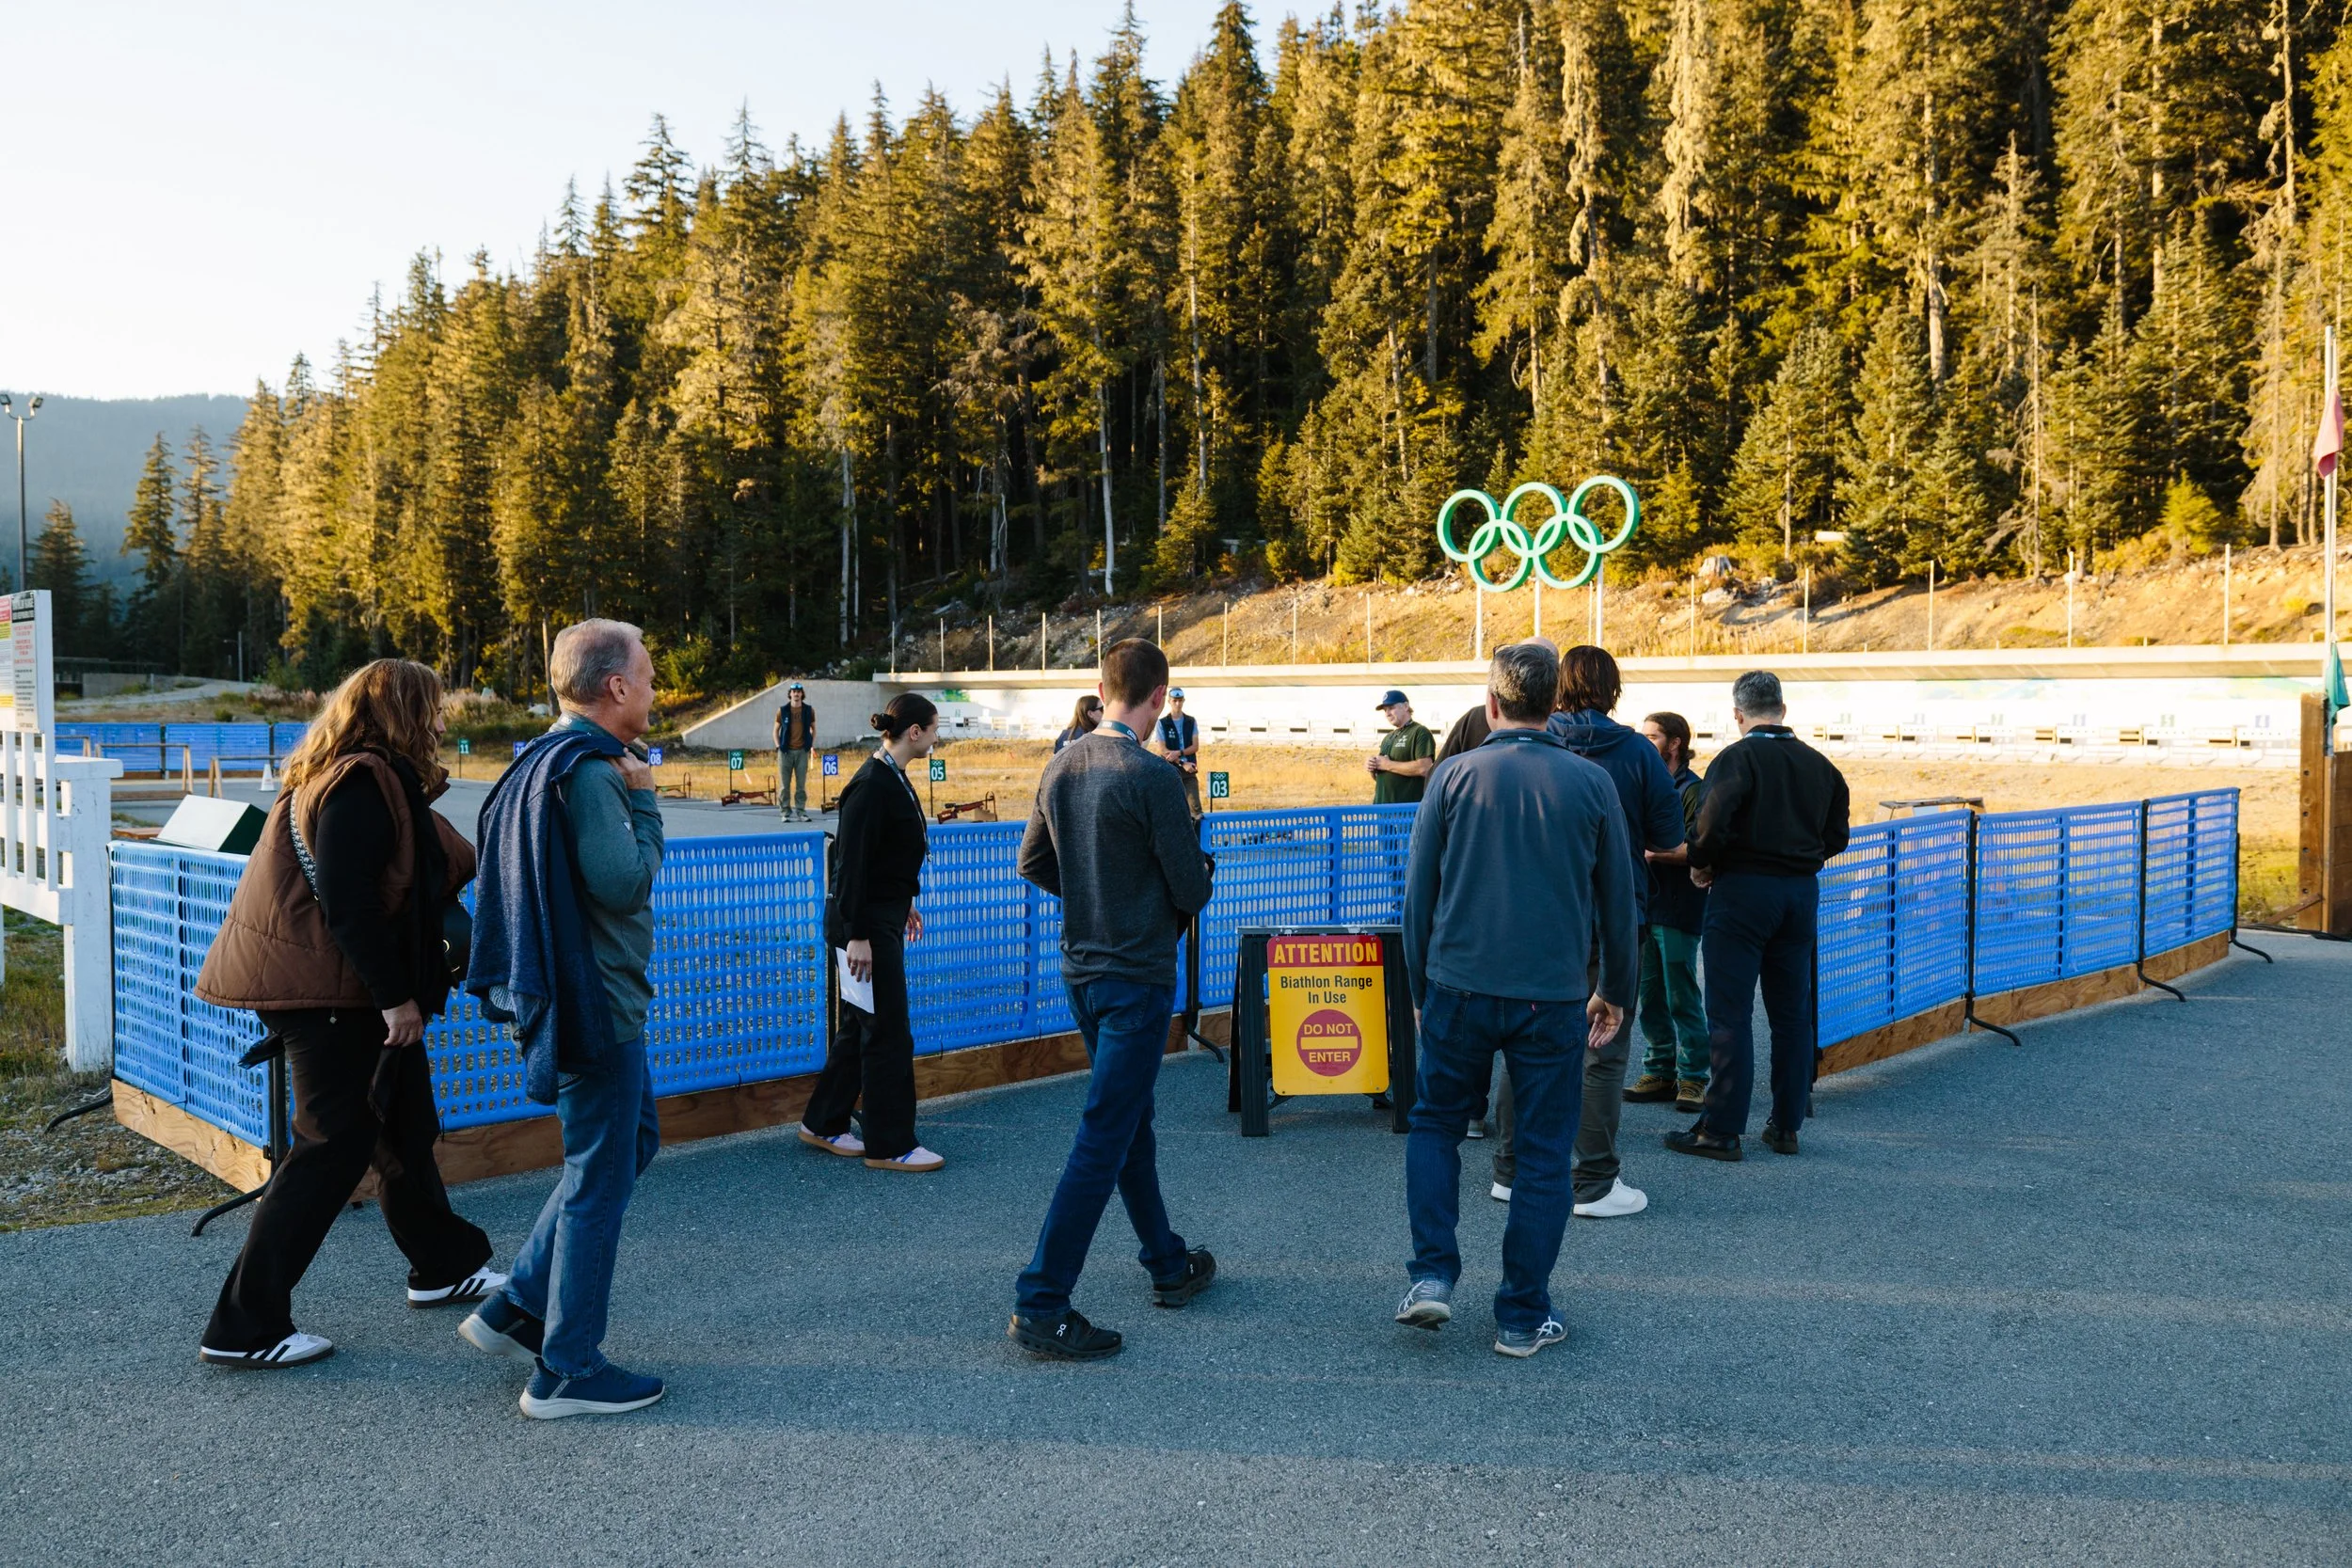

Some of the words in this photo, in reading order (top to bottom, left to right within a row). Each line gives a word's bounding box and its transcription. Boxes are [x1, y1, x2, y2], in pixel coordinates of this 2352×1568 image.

[460, 744, 469, 754] 11
[650, 753, 662, 765] 08
[731, 757, 742, 769] 07
[824, 762, 837, 774] 06
[930, 767, 945, 781] 05
[1213, 780, 1228, 797] 03
[1274, 942, 1377, 963] ATTENTION
[1280, 975, 1330, 989] Biathlon
[1334, 975, 1373, 990] Range
[1308, 991, 1319, 1004] In
[1324, 991, 1347, 1004] Use
[1303, 1023, 1323, 1035] DO
[1326, 1023, 1353, 1035] NOT
[1309, 1052, 1351, 1063] ENTER
